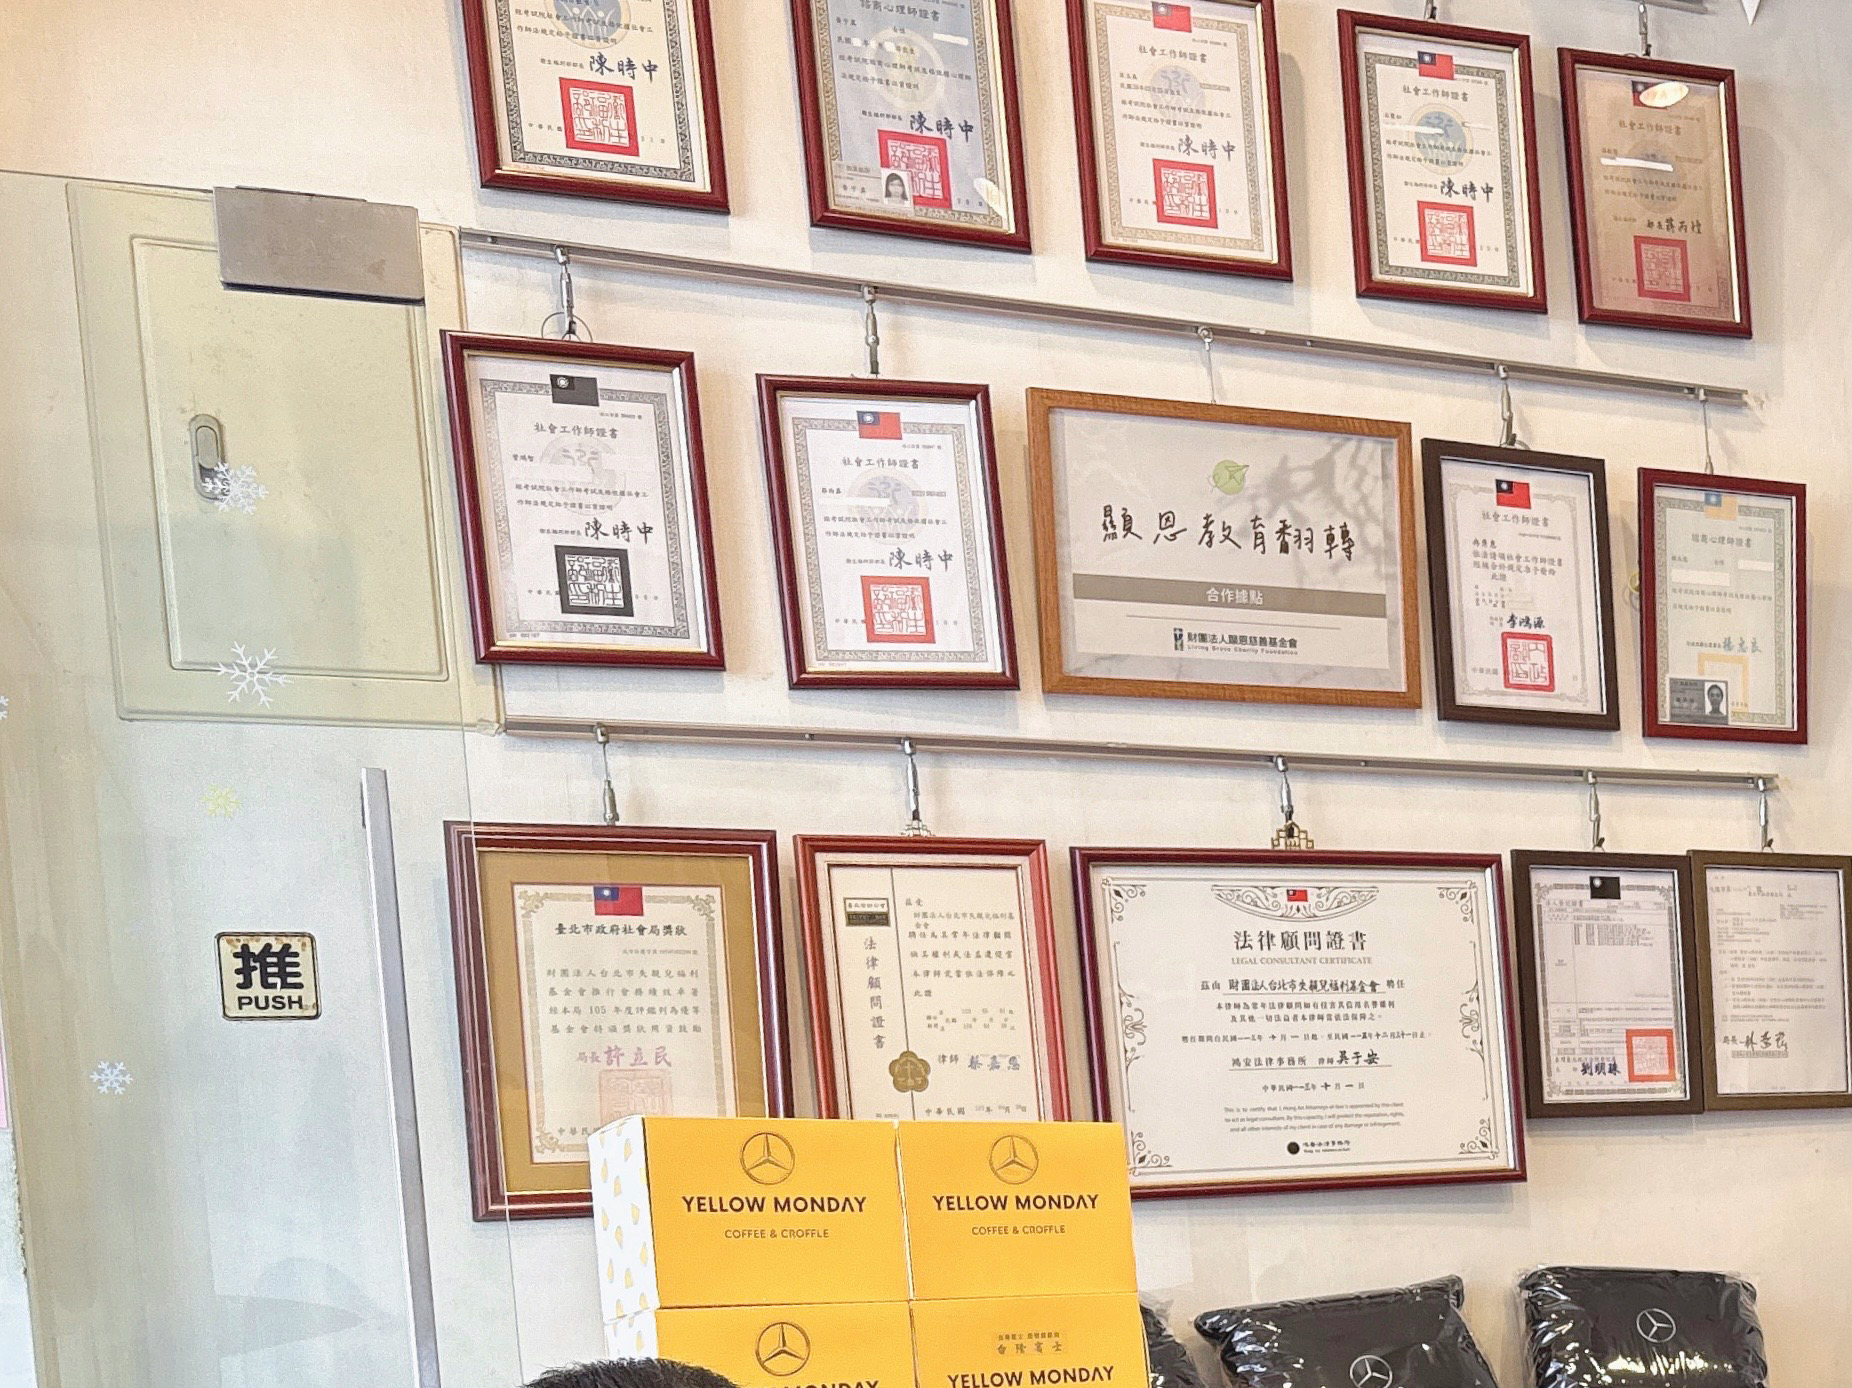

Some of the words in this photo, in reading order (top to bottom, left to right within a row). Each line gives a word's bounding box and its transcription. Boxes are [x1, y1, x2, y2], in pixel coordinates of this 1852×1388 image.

[590, 51, 658, 83] 陳時中
[910, 111, 974, 143] 陳時中
[1178, 134, 1236, 162] 陳時中
[1440, 176, 1494, 203] 陳時中
[534, 422, 619, 439] 社會工作師證書
[842, 457, 919, 469] 社會工作師證書
[584, 517, 654, 545] 陳時中
[1102, 504, 1355, 562] 顯恩教育翻轉
[889, 547, 954, 572] 陳時中
[1205, 587, 1264, 605] 合作據點
[555, 923, 688, 937] 臺北市政府社會局獎狀
[1233, 930, 1367, 951] 法律顧問證書
[232, 942, 304, 989] 推
[1231, 957, 1258, 965] LEGAL
[864, 935, 887, 1049] 法律顧問證書
[237, 995, 303, 1010] PUSH
[682, 1196, 766, 1213] YELLOW
[774, 1196, 867, 1213] MONDAY
[932, 1195, 1007, 1211] YELLOW
[1015, 1194, 1099, 1210] MONDAY
[725, 1229, 766, 1239] COFFEE
[770, 1229, 778, 1239] &
[782, 1228, 829, 1239] CROFFLE
[971, 1225, 1009, 1236] COFFEE
[1012, 1225, 1020, 1235] &
[1023, 1225, 1066, 1235] CROFFLE
[1030, 1366, 1114, 1385] MONDAY
